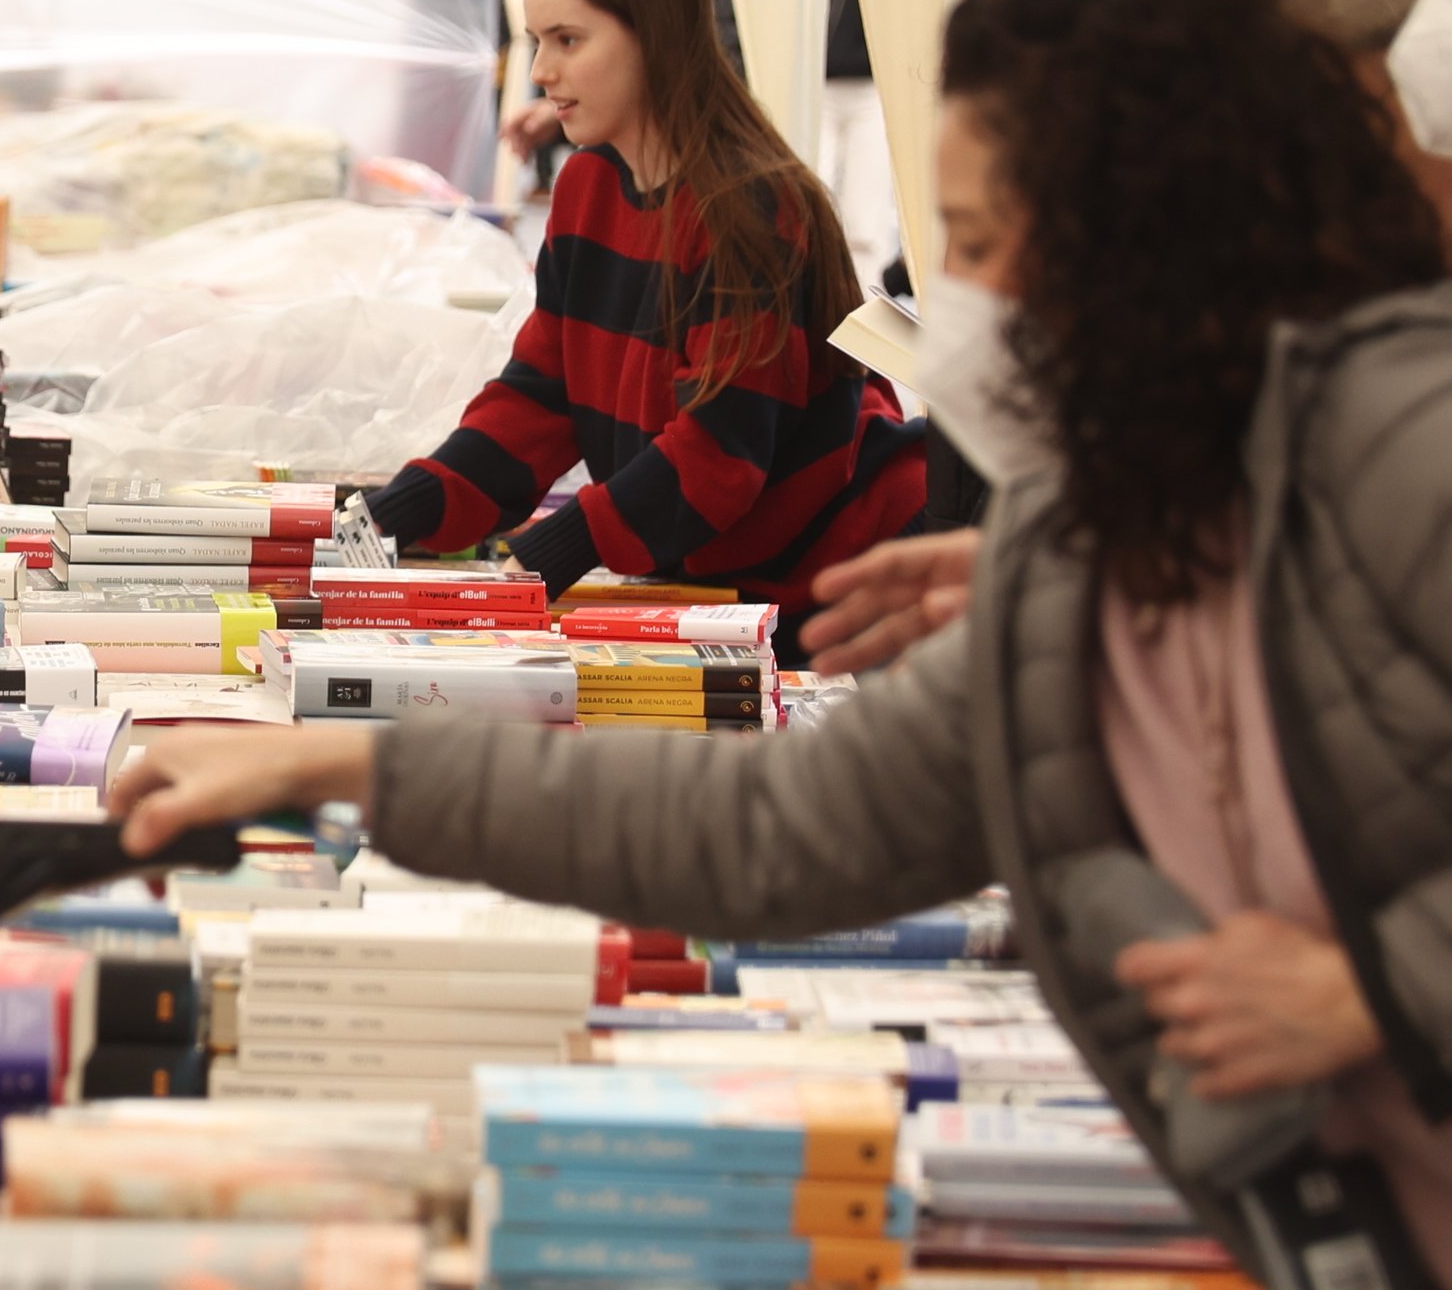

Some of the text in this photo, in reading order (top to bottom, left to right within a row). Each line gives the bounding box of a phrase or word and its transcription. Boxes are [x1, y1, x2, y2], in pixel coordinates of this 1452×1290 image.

[99, 546, 125, 554] paraules
[346, 590, 357, 599] de
[358, 590, 368, 599] la
[369, 590, 404, 600] família
[353, 617, 364, 626] de
[365, 616, 374, 626] la
[376, 617, 411, 627] família
[640, 624, 673, 635] Parla bé,
[665, 675, 693, 683] NEGRA
[413, 681, 448, 707] Sira
[666, 699, 693, 707] NEGRA
[861, 929, 898, 943] Piñol
